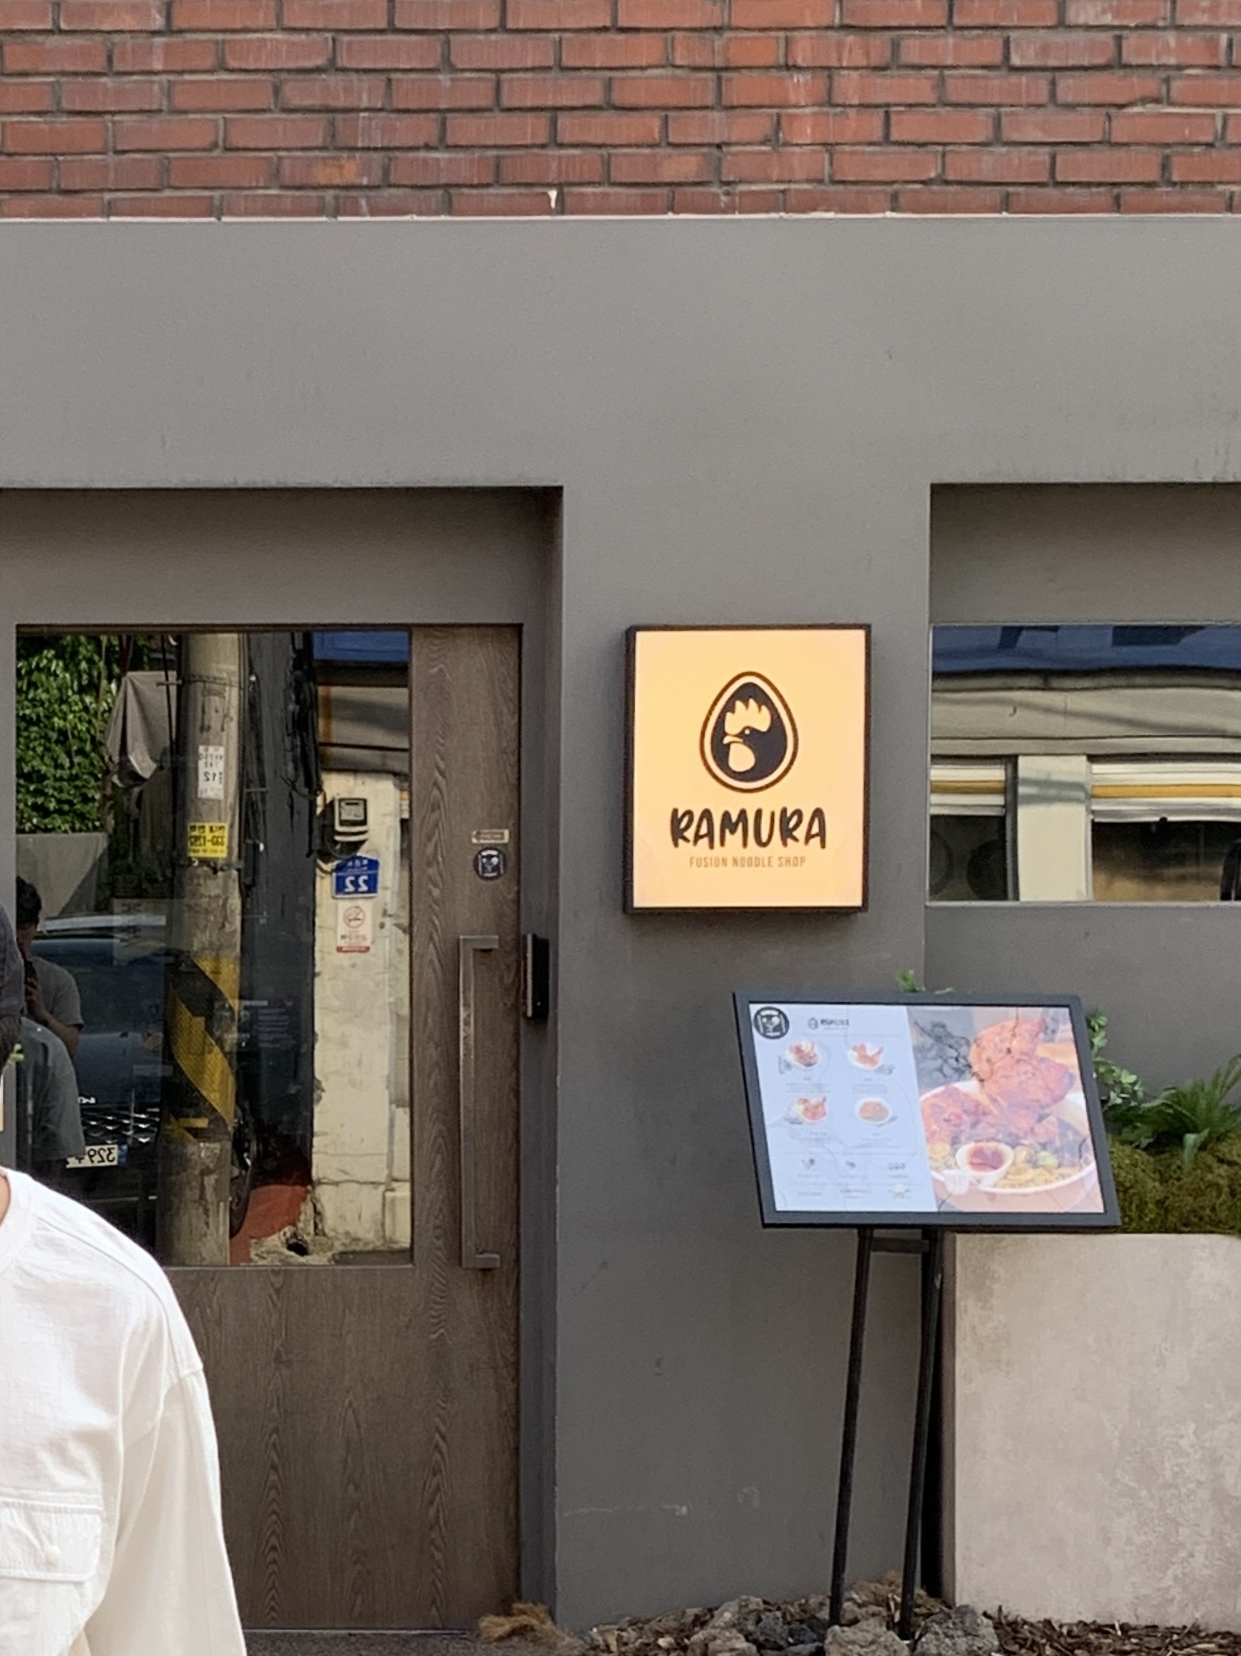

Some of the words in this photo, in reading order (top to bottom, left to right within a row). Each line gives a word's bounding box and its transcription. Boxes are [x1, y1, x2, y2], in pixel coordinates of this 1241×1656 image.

[670, 806, 826, 850] RAMURA
[689, 855, 728, 868] FUSION
[732, 855, 773, 868] NOODLE
[777, 855, 806, 868] SHOP
